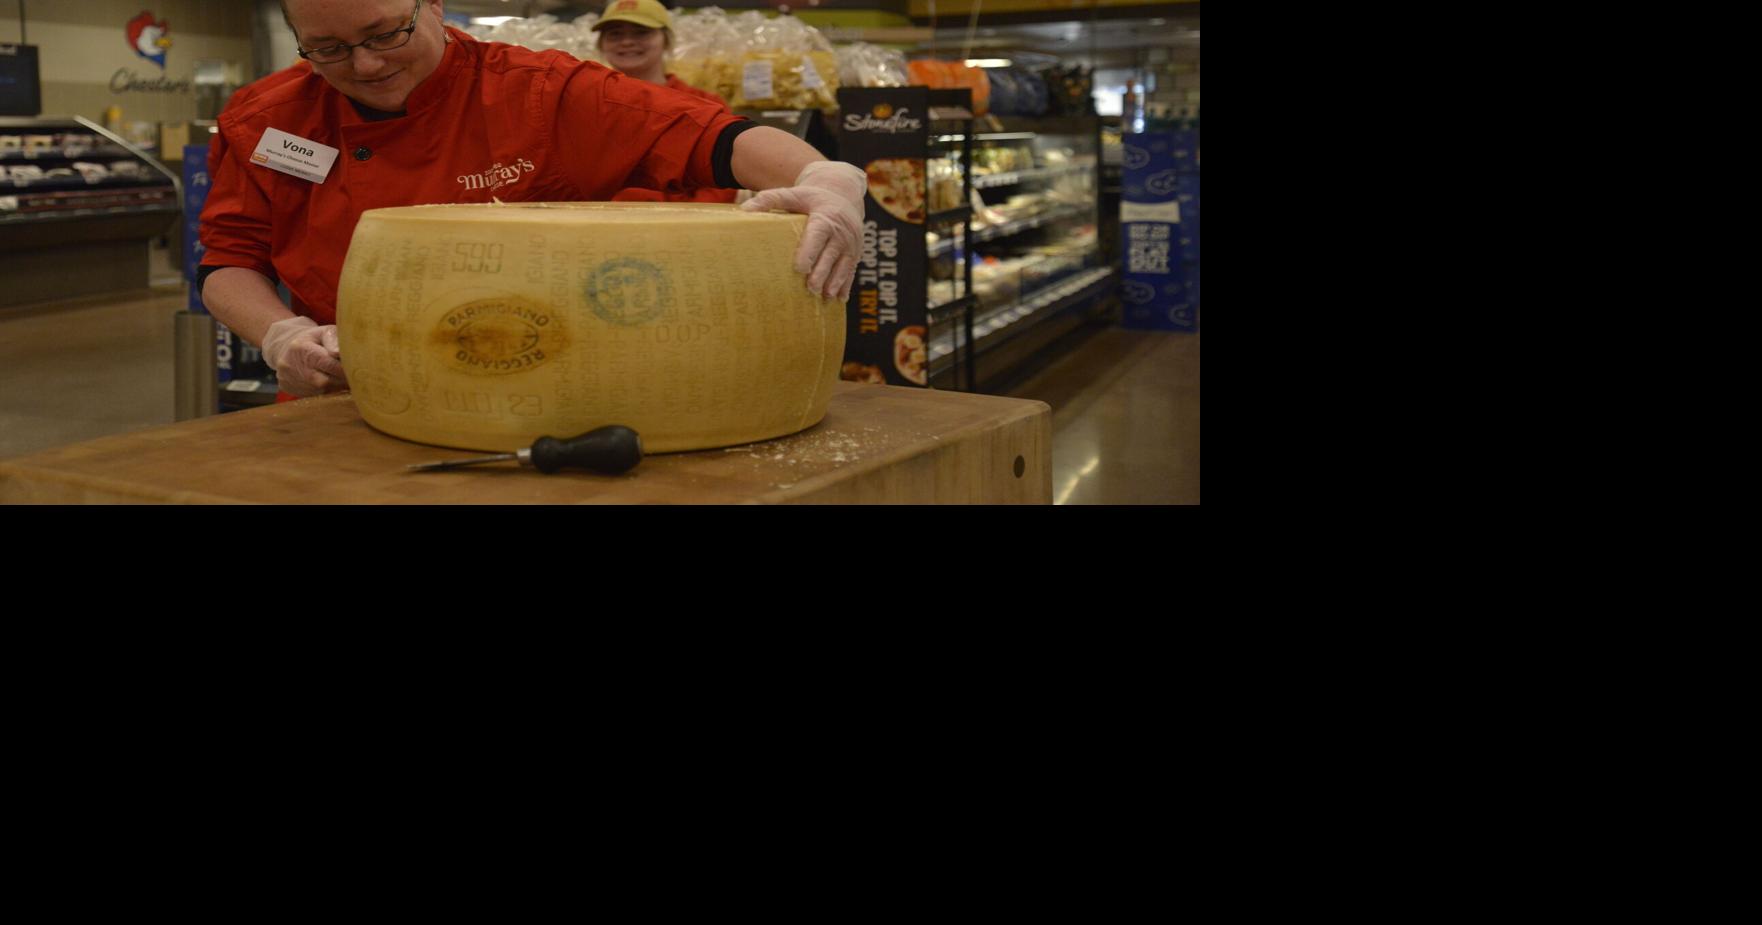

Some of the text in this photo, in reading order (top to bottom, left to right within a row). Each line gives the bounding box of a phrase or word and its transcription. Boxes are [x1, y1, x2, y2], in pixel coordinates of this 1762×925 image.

[843, 107, 922, 134] Stonefire
[282, 139, 314, 157] Vona
[456, 158, 536, 191] Murray's
[861, 220, 878, 269] SCOOP
[879, 228, 898, 258] TOP
[451, 242, 504, 274] 599
[859, 288, 878, 317] TRY
[879, 281, 898, 307] DIP
[448, 303, 549, 326] PARMIGIANO
[455, 349, 546, 370] REGGIANO
[507, 392, 544, 417] 23
